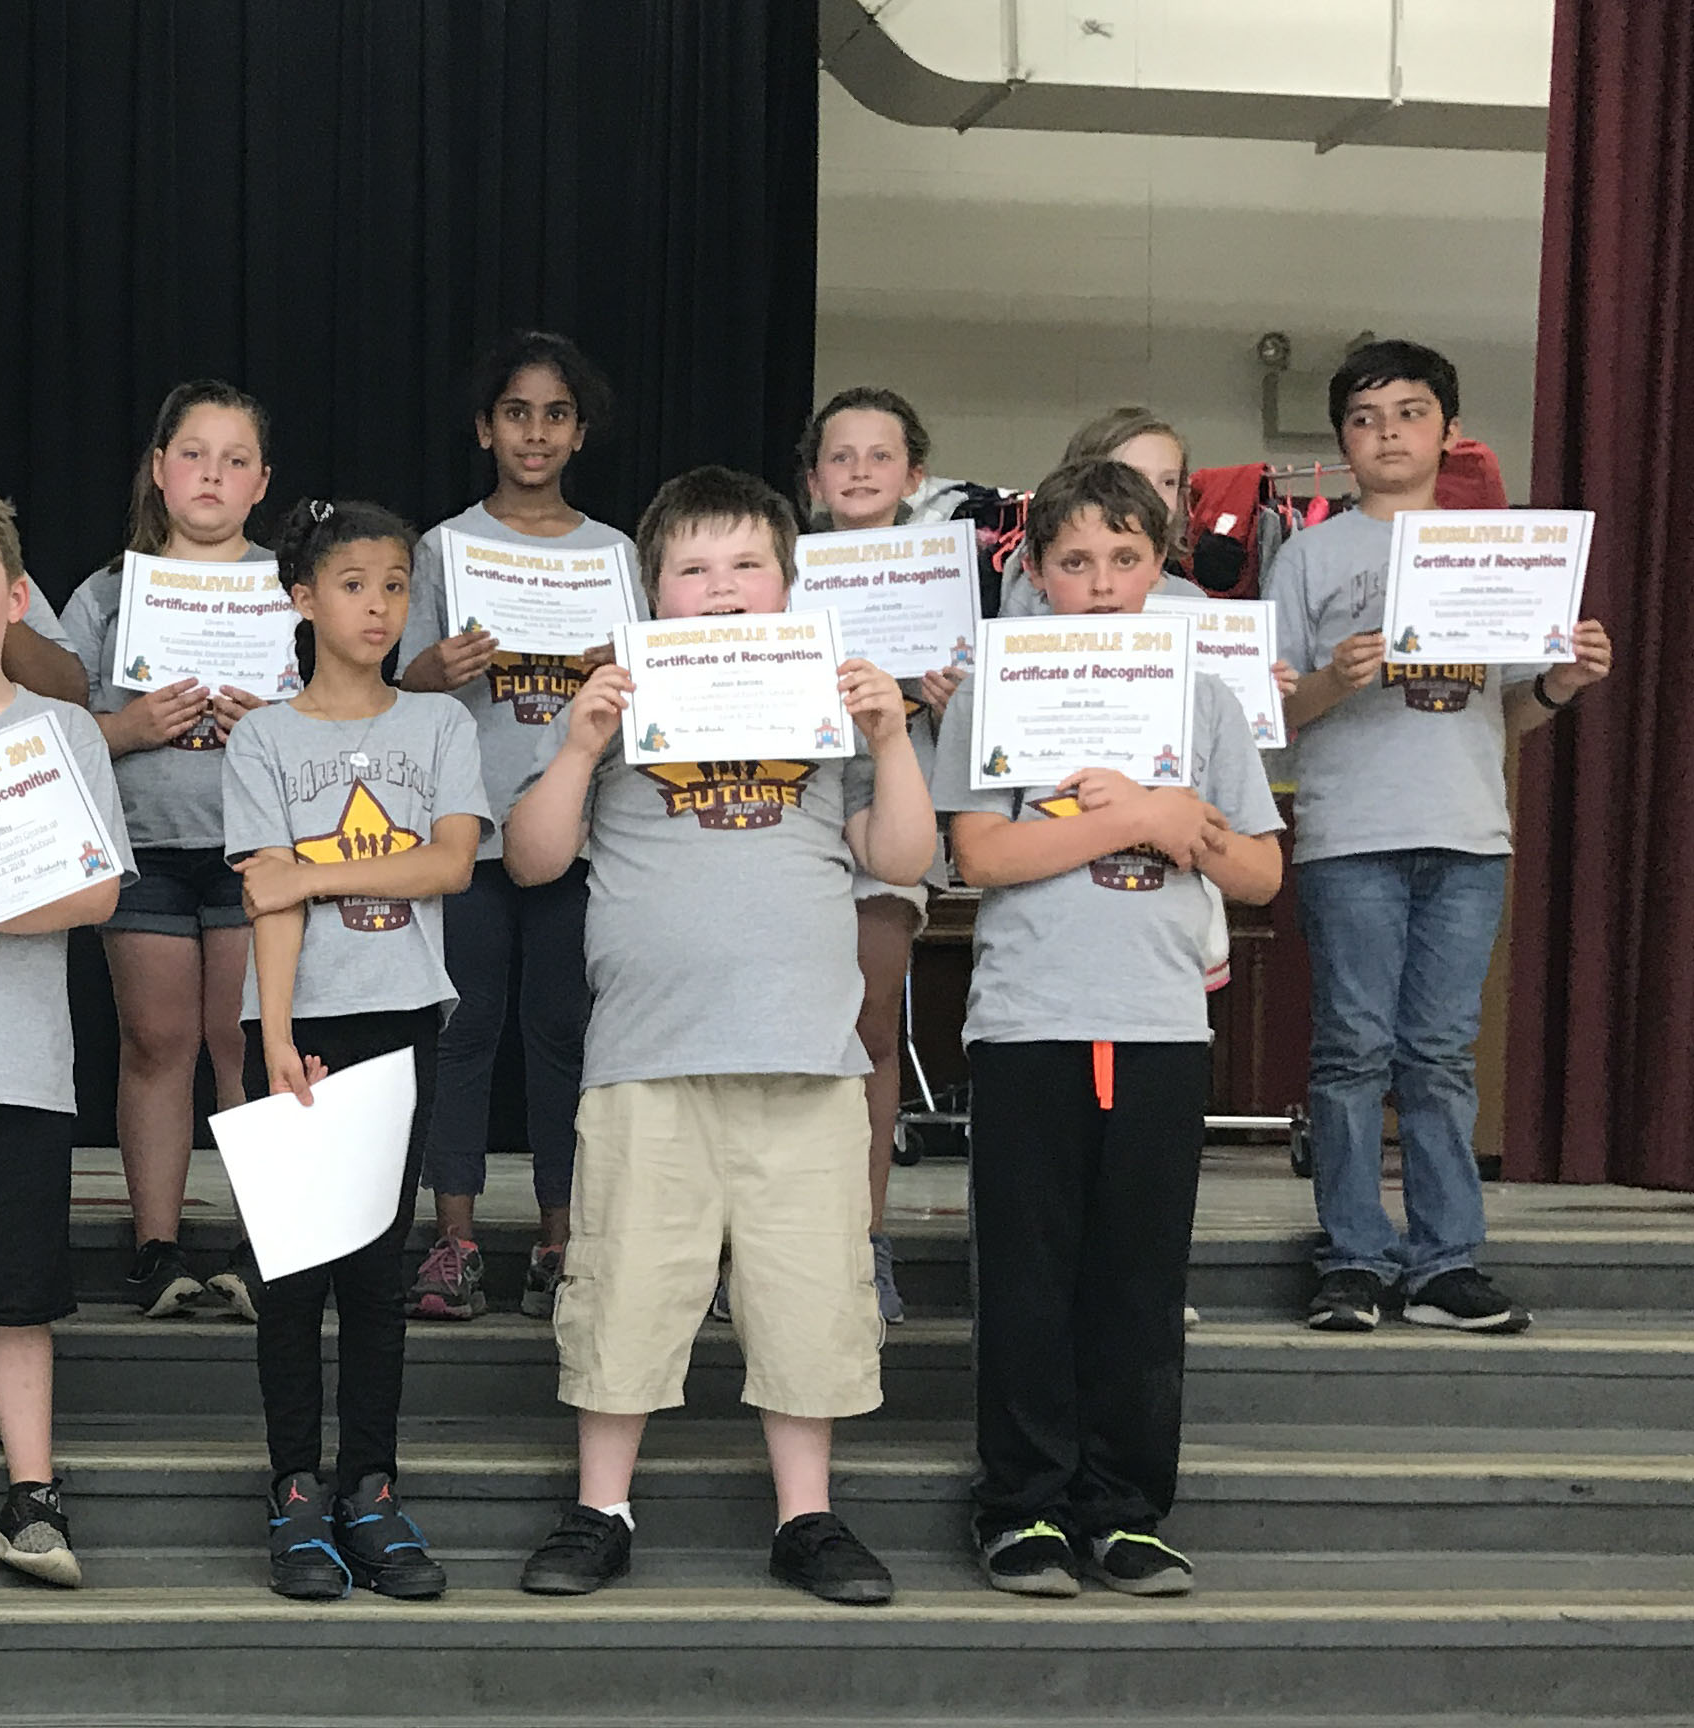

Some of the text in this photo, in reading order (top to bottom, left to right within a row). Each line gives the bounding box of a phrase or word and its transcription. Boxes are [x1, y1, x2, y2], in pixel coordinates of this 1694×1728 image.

[1414, 554, 1566, 570] Certificate of Recognition
[465, 565, 612, 590] Certificate of Recognition
[804, 566, 960, 591] Certificate of Recognition
[145, 594, 295, 616] Certificate of Recognition
[646, 650, 822, 668] Certificate of Recognition
[1196, 641, 1259, 658] Recognition
[1000, 664, 1174, 682] Certificate of Recognition
[5, 736, 47, 767] 2018
[300, 760, 338, 802] ARE
